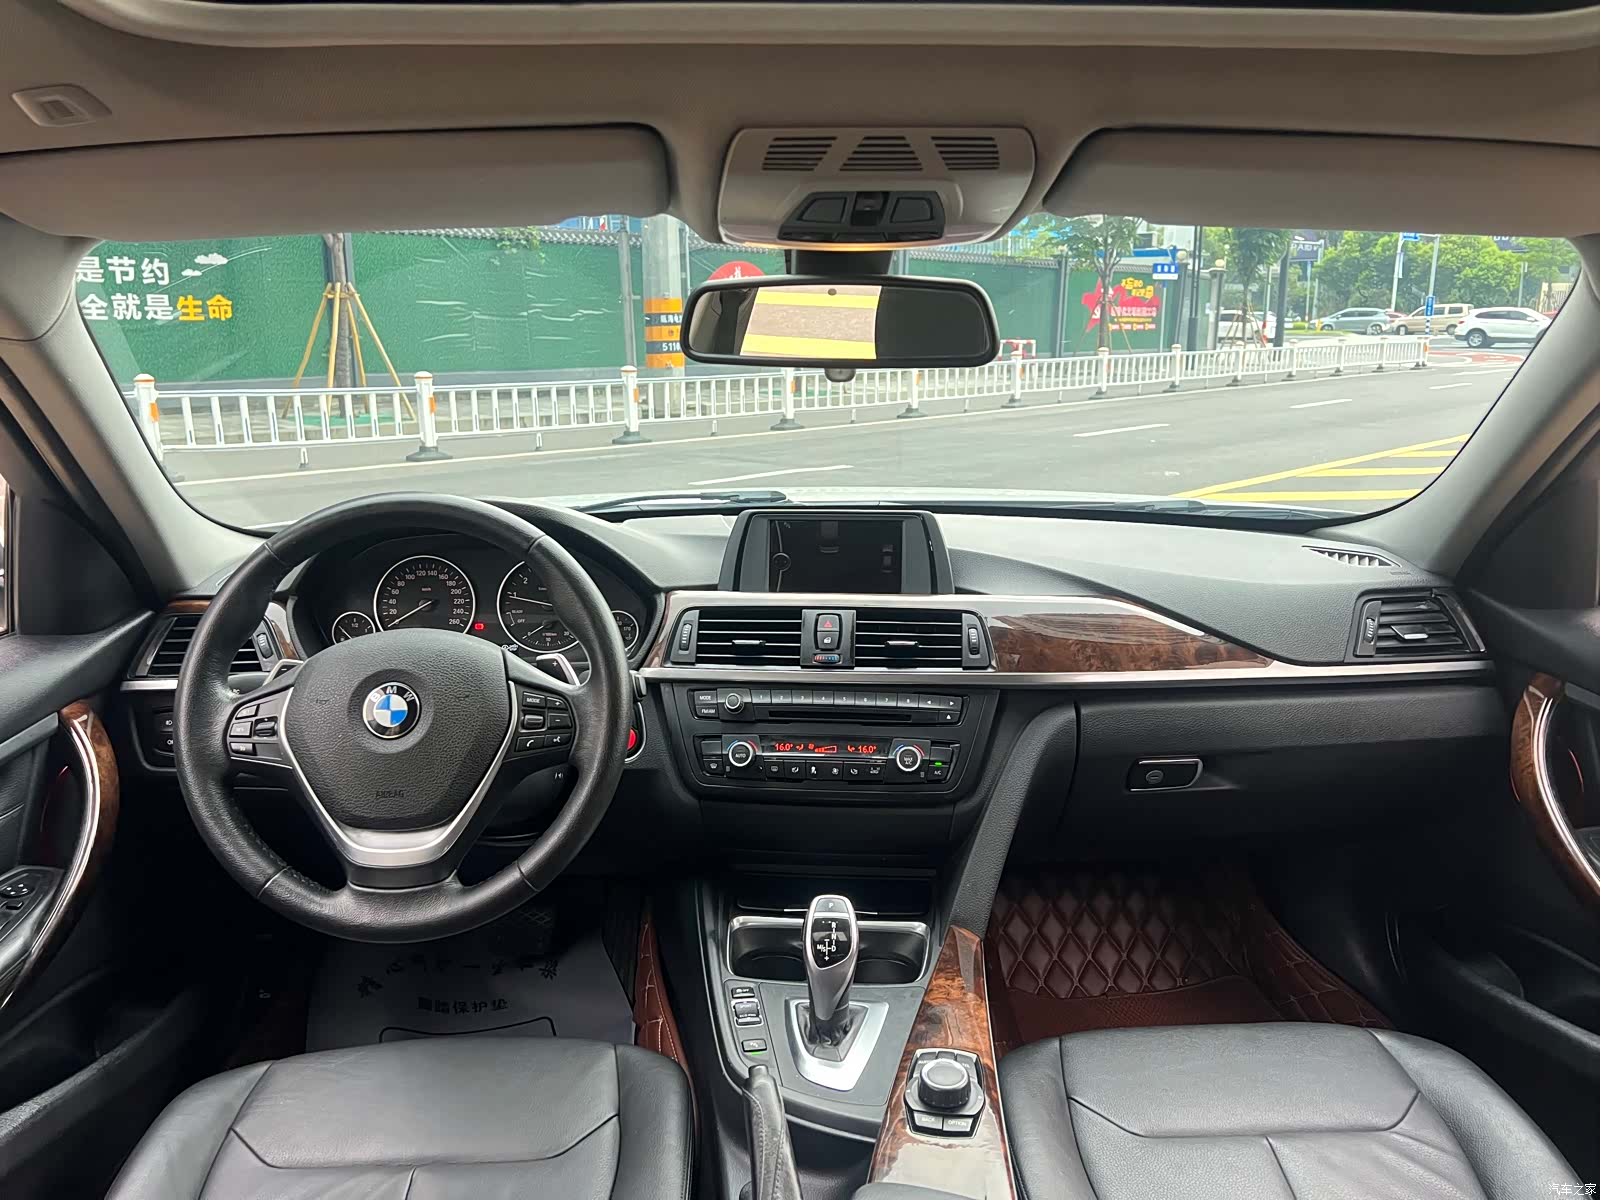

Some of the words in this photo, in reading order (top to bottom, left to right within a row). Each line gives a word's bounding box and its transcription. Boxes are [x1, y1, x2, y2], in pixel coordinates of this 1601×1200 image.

[76, 256, 169, 285] 是节约
[80, 293, 233, 321] 全就是生命
[370, 685, 415, 703] BMW
